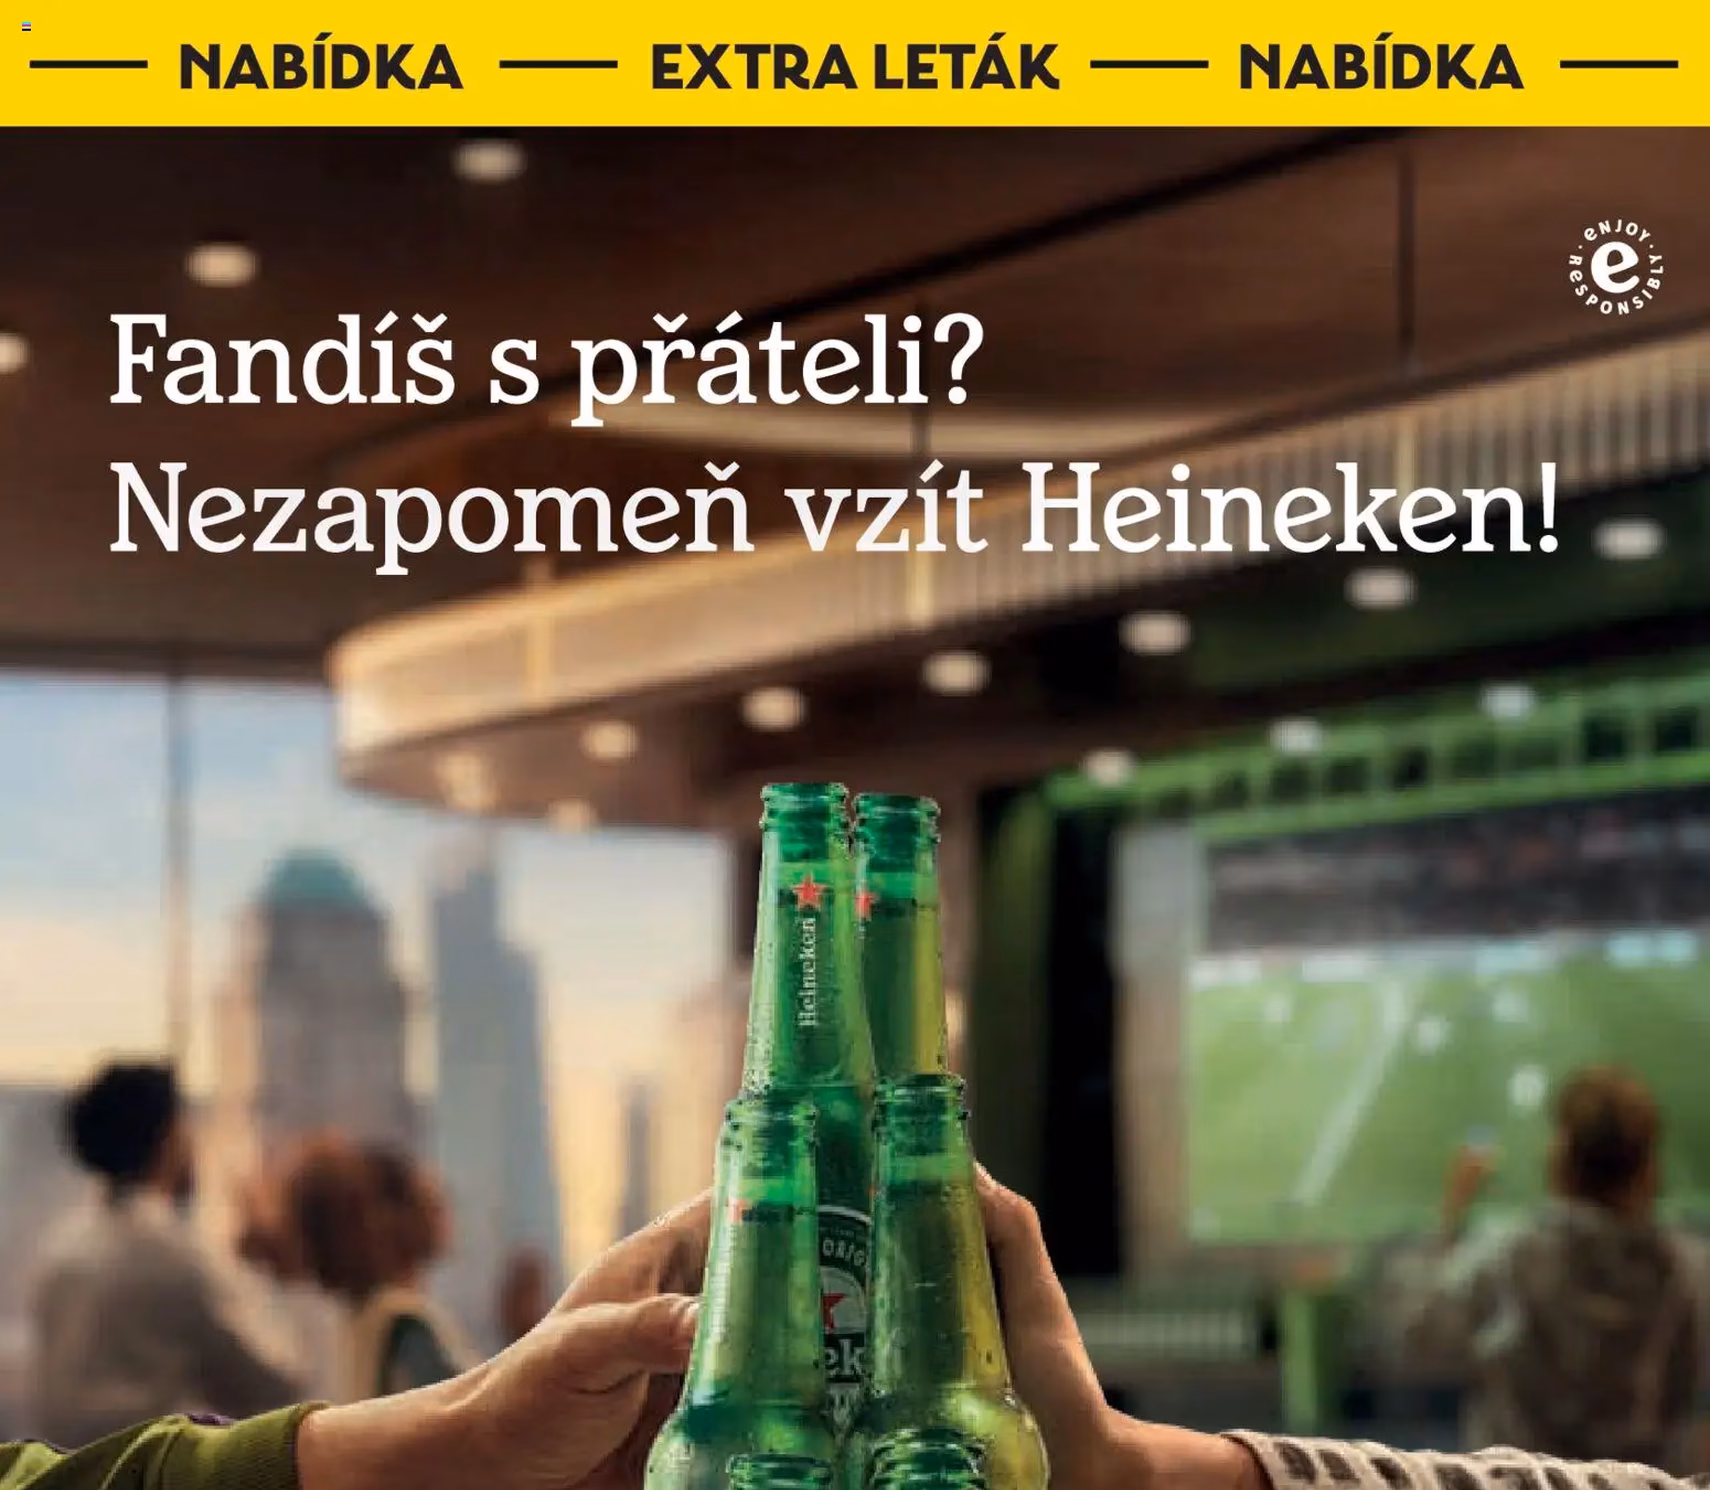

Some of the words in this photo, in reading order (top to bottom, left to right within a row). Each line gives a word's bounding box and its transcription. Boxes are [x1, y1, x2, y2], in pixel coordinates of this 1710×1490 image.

[180, 31, 464, 90] NABÍDKA
[652, 43, 858, 90] EXTRA
[874, 31, 1061, 90] LETÁK
[1240, 31, 1525, 90] NABÍDKA
[109, 310, 455, 405] Fandíš
[490, 338, 540, 405] s
[570, 310, 985, 428] přáteli?
[109, 461, 755, 576] Nezapomeň
[784, 458, 989, 554] vzít
[1021, 461, 1559, 554] Heineken!
